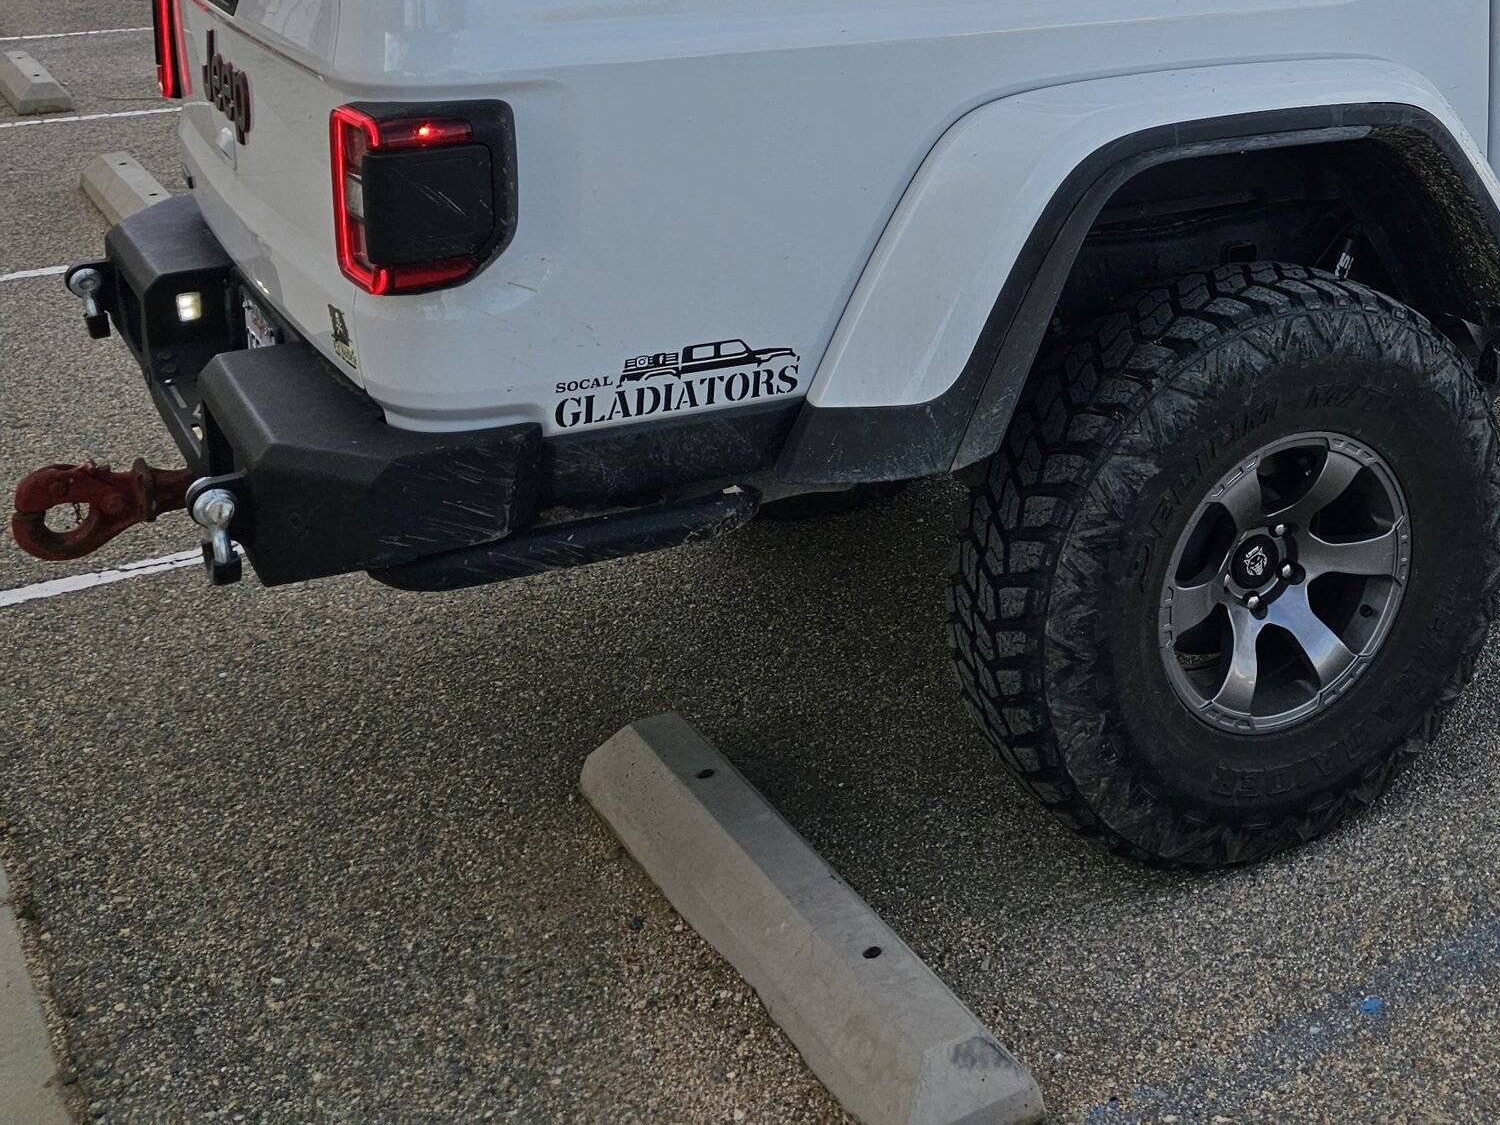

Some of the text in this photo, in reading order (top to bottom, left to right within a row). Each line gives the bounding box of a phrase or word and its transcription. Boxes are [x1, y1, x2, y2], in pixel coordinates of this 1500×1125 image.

[202, 28, 252, 146] Jeep
[554, 364, 800, 428] GLADIATORS
[555, 376, 613, 394] SOCAL
